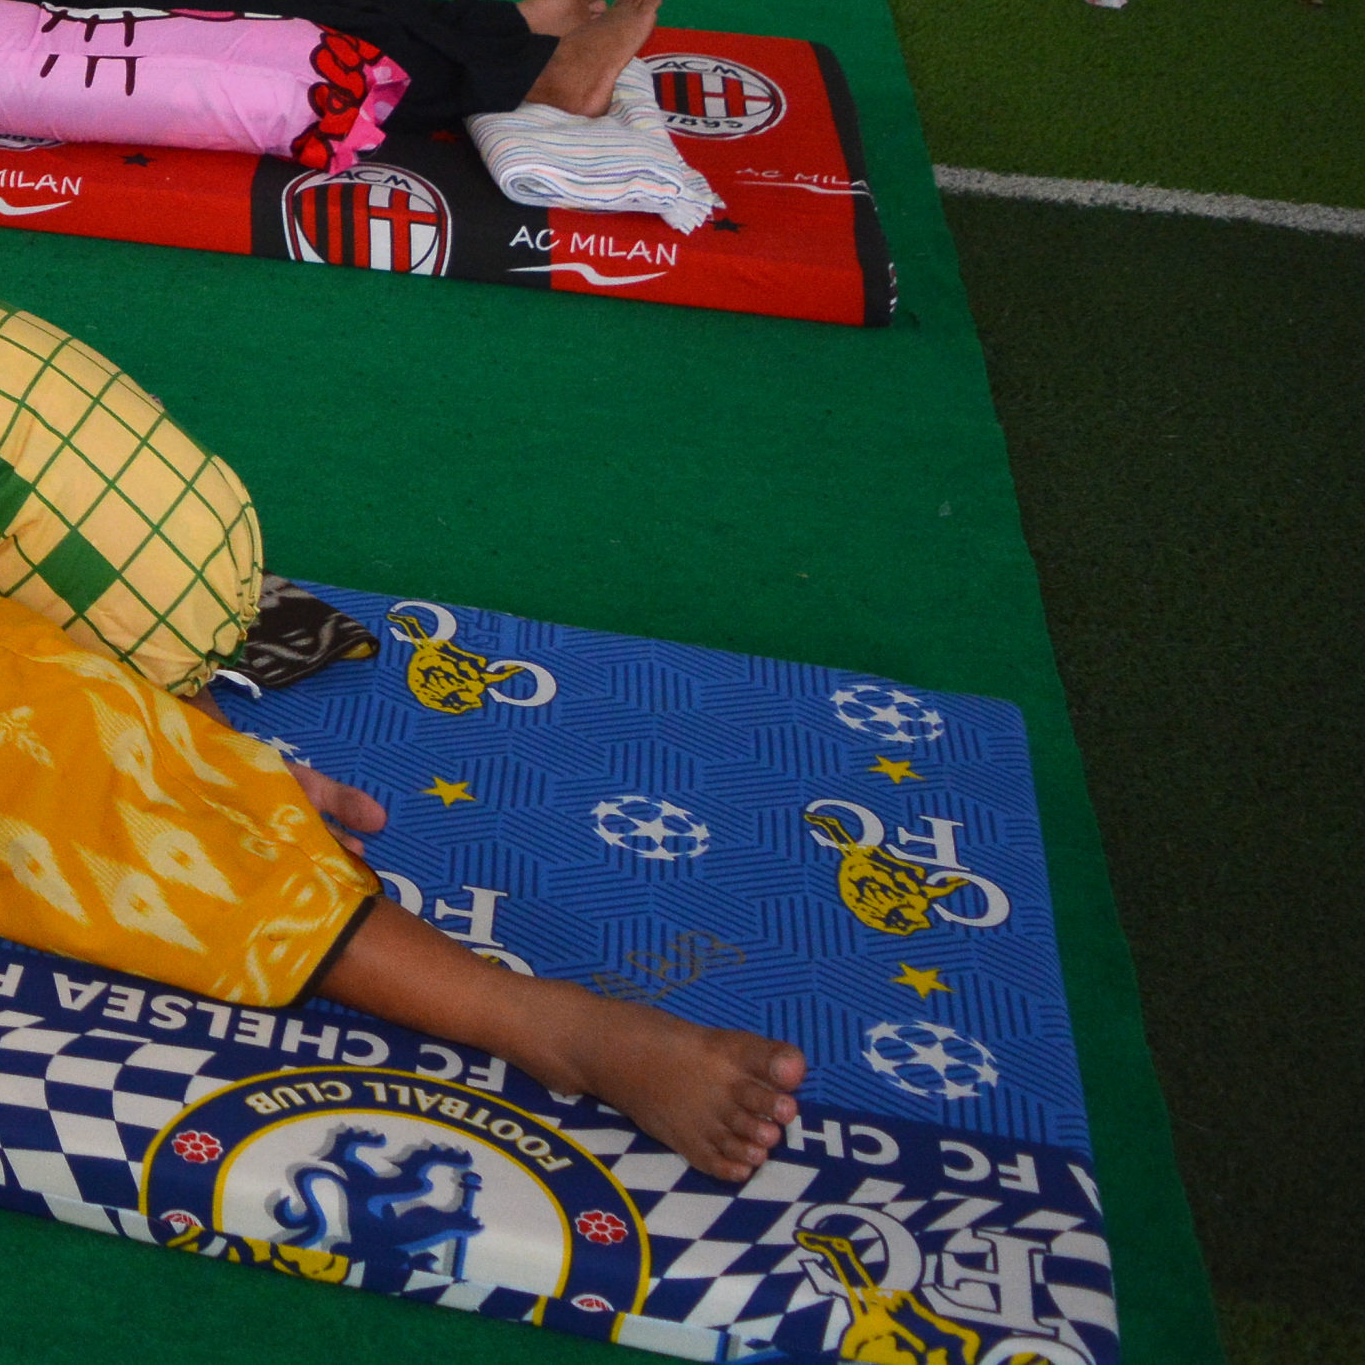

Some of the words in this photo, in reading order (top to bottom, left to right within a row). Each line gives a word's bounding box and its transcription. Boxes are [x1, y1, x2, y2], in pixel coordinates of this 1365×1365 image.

[652, 59, 742, 78] ACM
[332, 163, 413, 192] ACM
[734, 167, 782, 179] AC
[508, 223, 559, 255] AC
[565, 232, 680, 269] MILAN
[51, 971, 390, 1068] CHELSEA
[414, 1042, 509, 1095] FC
[937, 1139, 1041, 1195] FC
[244, 1080, 353, 1115] CLUB
[361, 1080, 574, 1172] FOOTBALL
